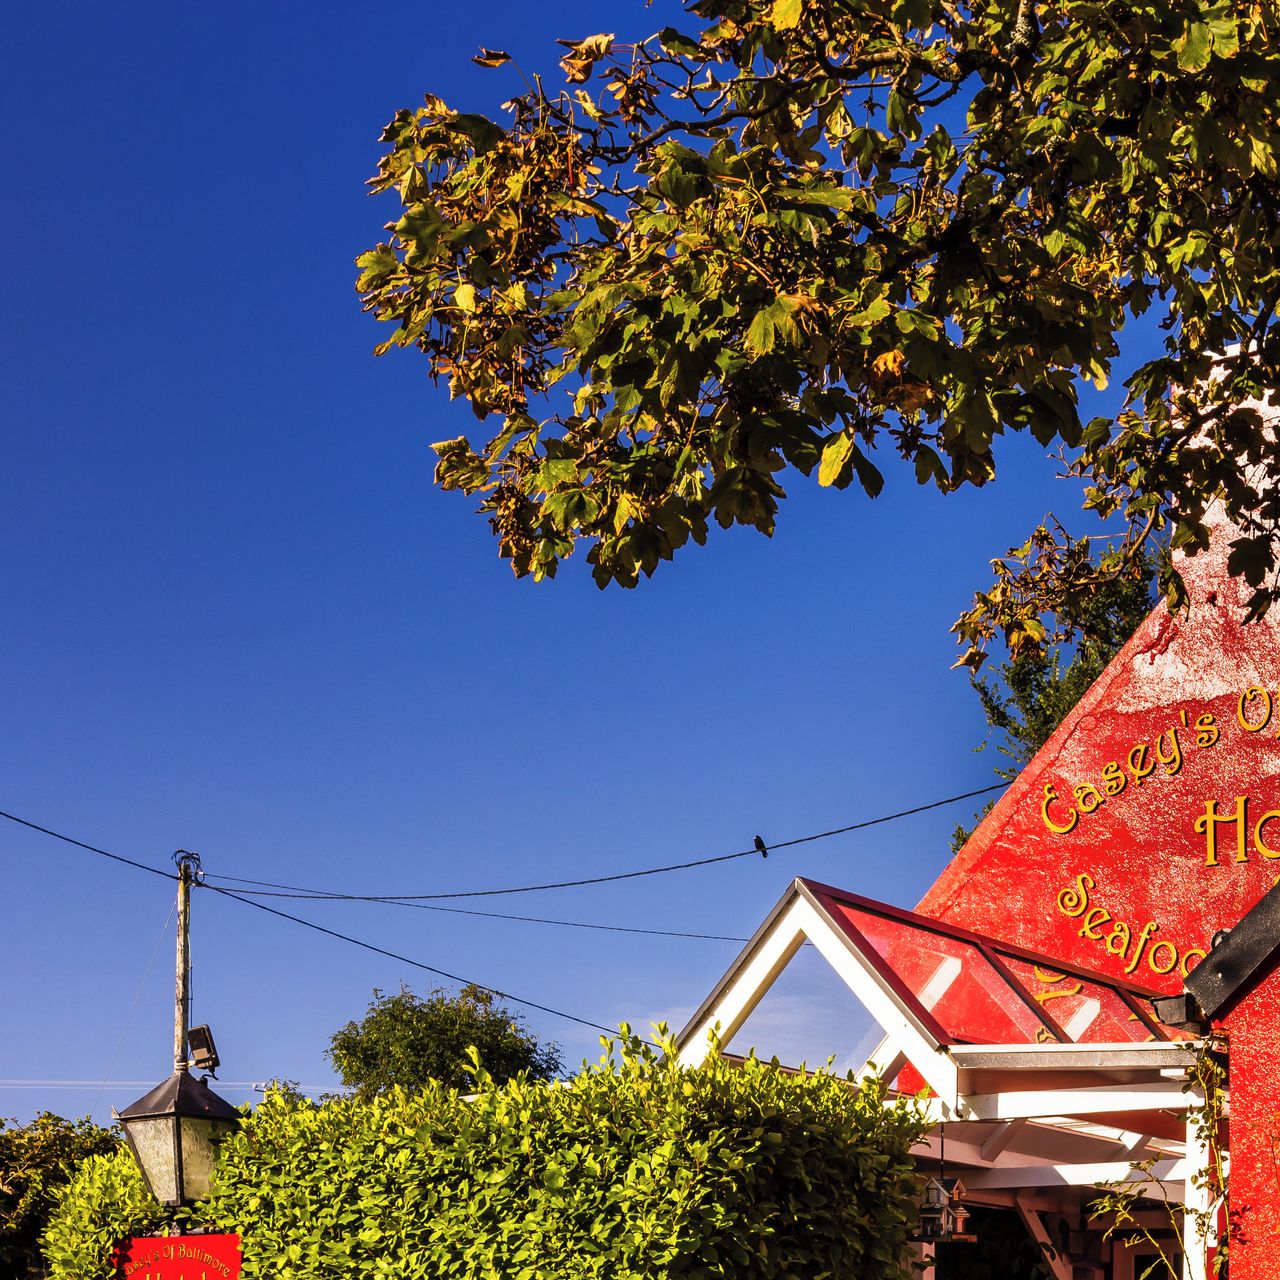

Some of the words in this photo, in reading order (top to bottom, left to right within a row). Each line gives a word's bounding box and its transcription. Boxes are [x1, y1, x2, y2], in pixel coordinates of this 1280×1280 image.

[1041, 709, 1220, 835] Casey's
[163, 1244, 175, 1260] Of
[178, 1243, 231, 1278] Baltimore
